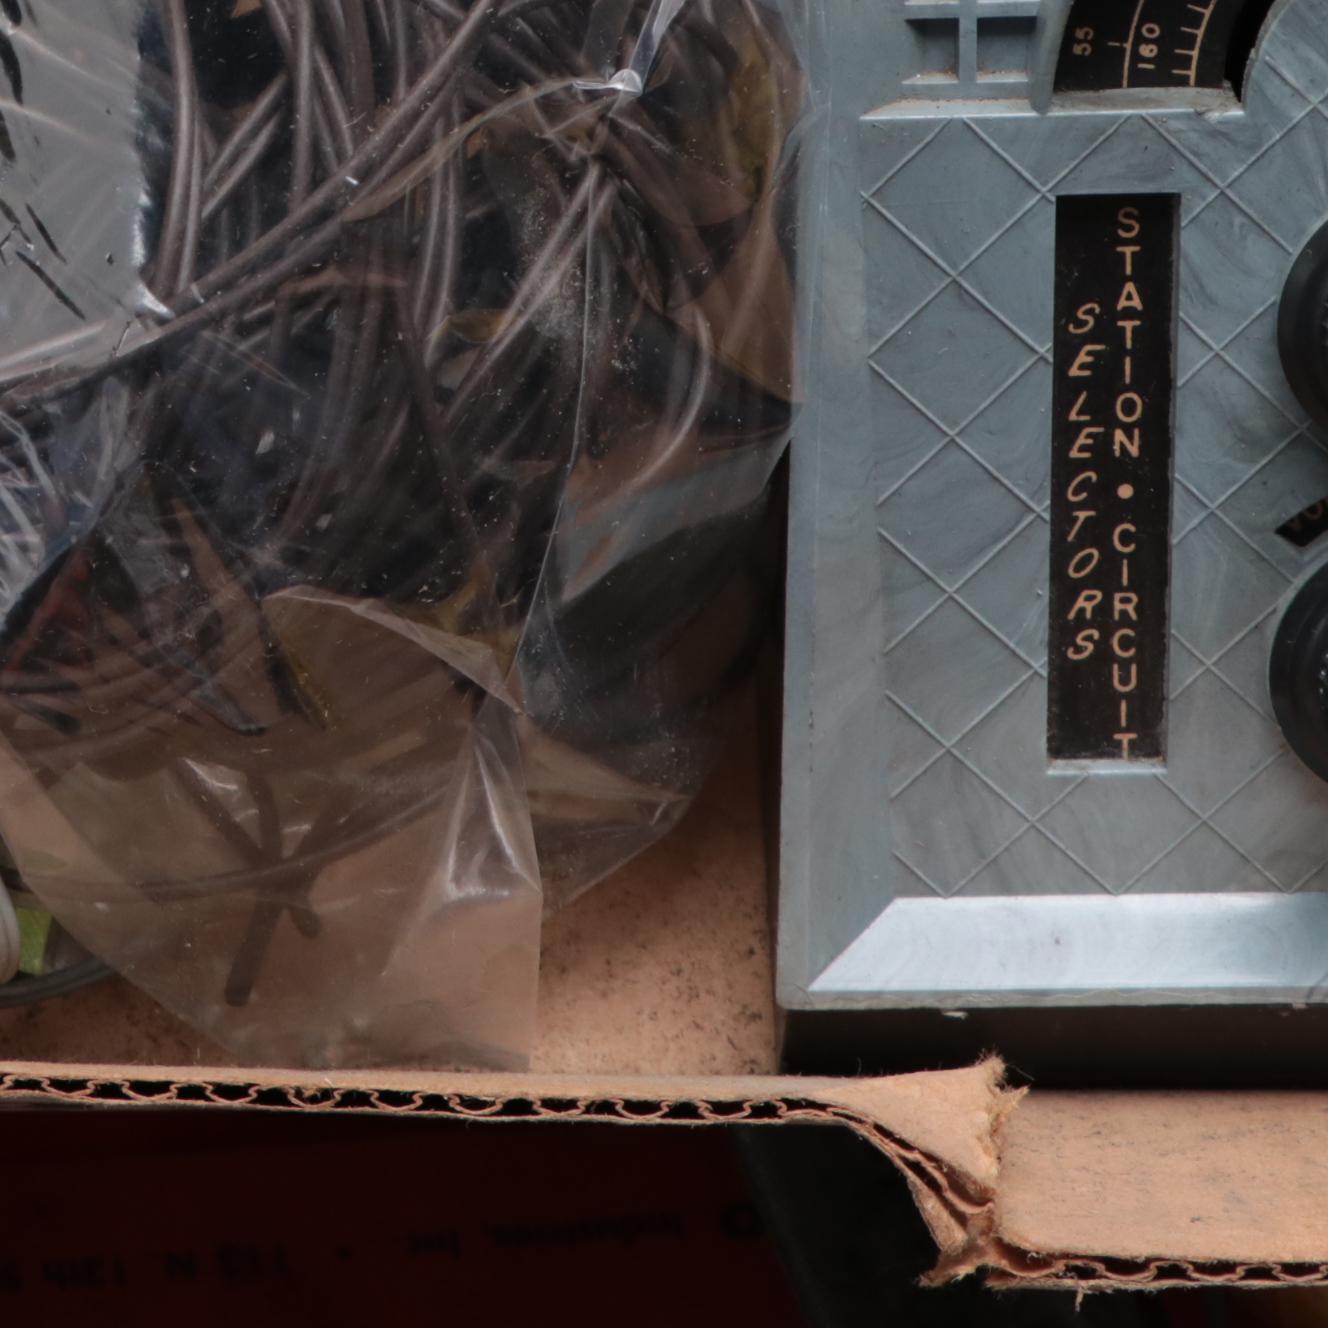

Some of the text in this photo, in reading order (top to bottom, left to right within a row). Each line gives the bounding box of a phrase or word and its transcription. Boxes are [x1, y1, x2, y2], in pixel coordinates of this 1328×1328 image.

[1067, 302, 1107, 660] SELECTORS
[1112, 206, 1143, 761] STATION CIRCUIT
